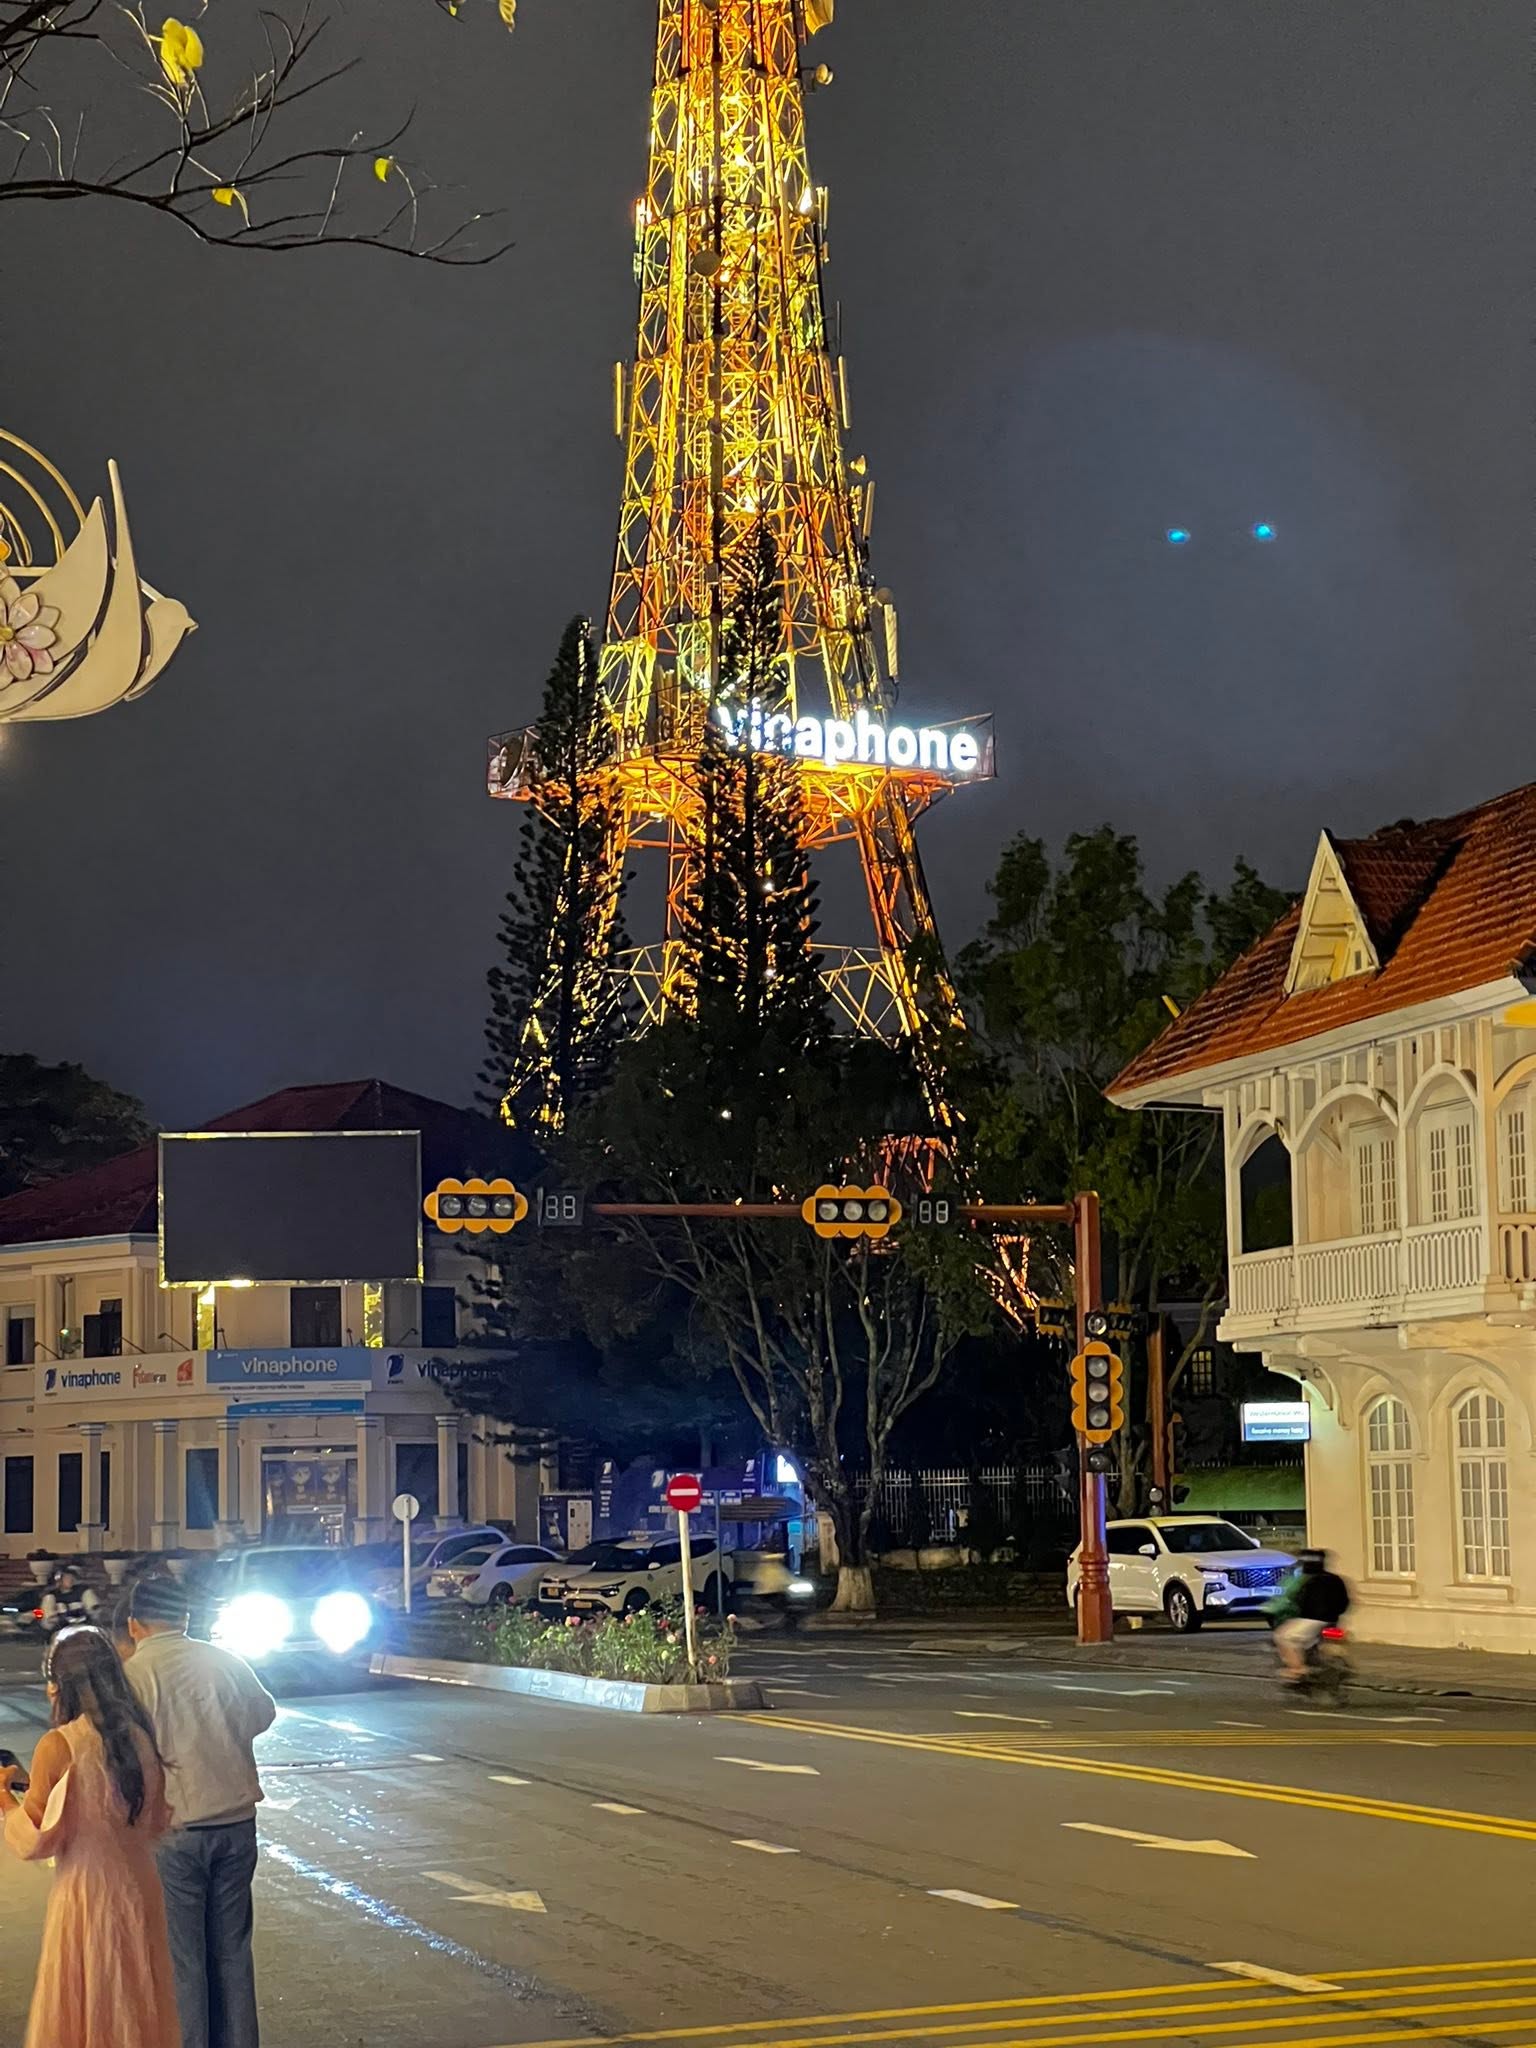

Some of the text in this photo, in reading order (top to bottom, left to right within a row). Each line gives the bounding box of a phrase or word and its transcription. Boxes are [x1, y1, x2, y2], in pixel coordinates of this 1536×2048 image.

[718, 697, 979, 771] vinaphone
[242, 1356, 338, 1376] vinaphone
[61, 1369, 121, 1389] vinaphone
